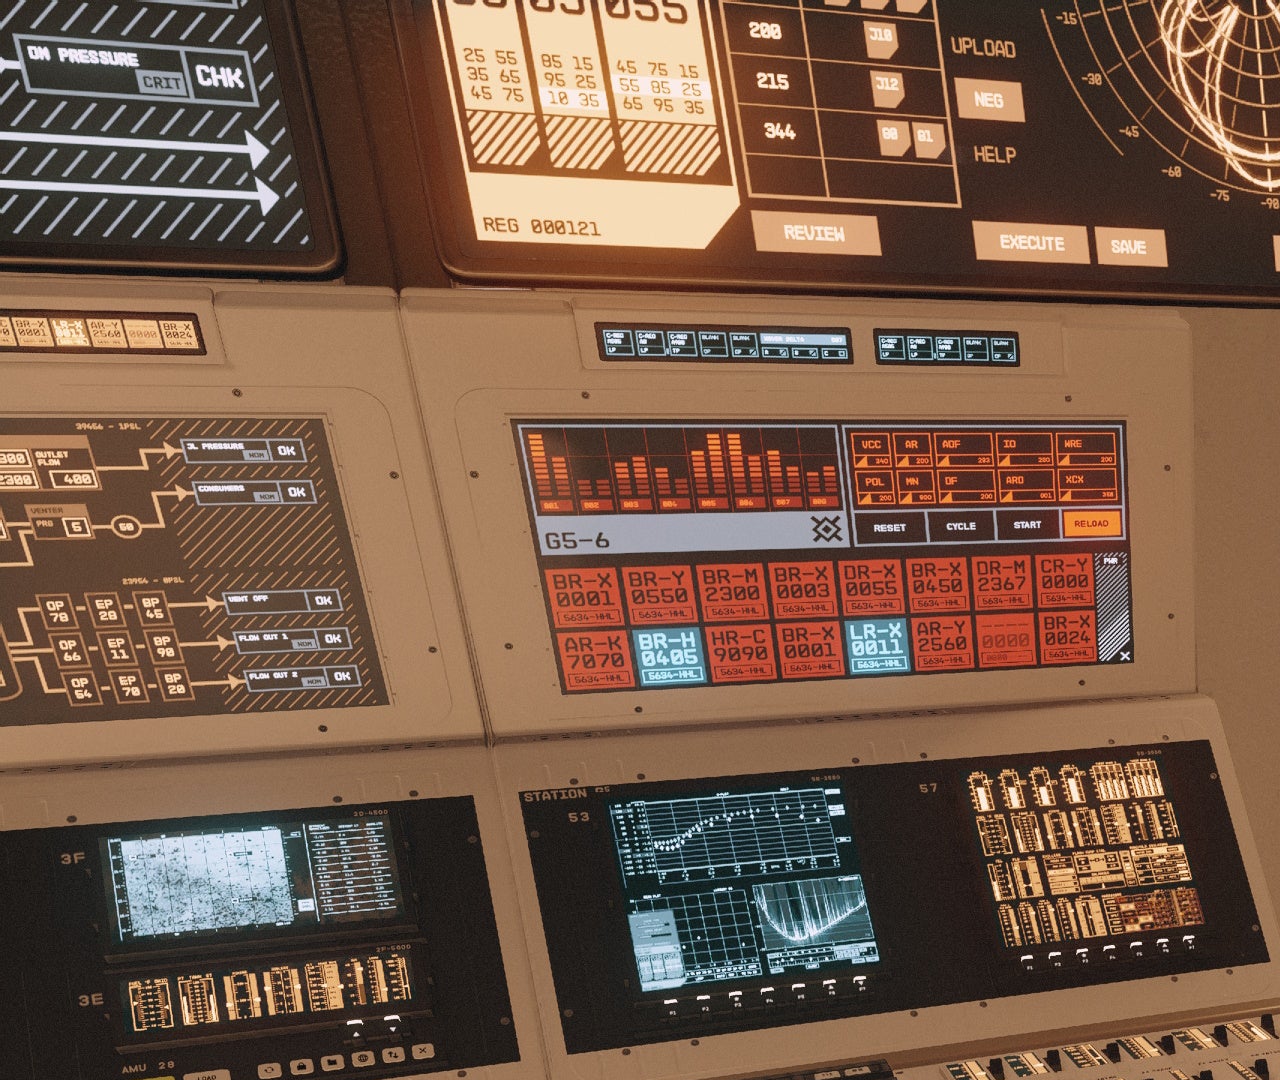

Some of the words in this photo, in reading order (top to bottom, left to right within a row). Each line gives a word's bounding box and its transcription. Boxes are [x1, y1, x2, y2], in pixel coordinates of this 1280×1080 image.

[1056, 12, 1078, 25] -15
[749, 22, 782, 40] 200
[950, 36, 1016, 59] UPLOAD
[58, 47, 140, 68] PRESSURE
[463, 47, 485, 63] 25
[495, 50, 517, 65] 55
[541, 53, 563, 69] 85
[573, 56, 593, 71] 15
[195, 64, 245, 89] CHK
[467, 66, 489, 82] 35
[500, 69, 521, 84] 65
[616, 60, 637, 75] 45
[648, 62, 668, 77] 75
[680, 64, 699, 79] 15
[142, 75, 181, 90] CRIT
[544, 72, 566, 87] 95
[575, 74, 597, 89] 25
[619, 78, 640, 93] 55
[651, 80, 671, 95] 85
[682, 82, 702, 97] 25
[756, 72, 790, 90] 215
[1081, 73, 1102, 86] -30
[471, 85, 492, 100] 45
[502, 87, 524, 102] 75
[549, 90, 569, 106] 10
[579, 93, 599, 108] 35
[973, 90, 1004, 109] NEG
[623, 96, 643, 111] 65
[653, 98, 674, 113] 95
[685, 100, 705, 115] 35
[764, 122, 796, 140] 344
[1119, 125, 1140, 138] -45
[973, 144, 1017, 164] HELP
[1161, 165, 1182, 178] -60
[1210, 190, 1230, 202] -75
[1260, 197, 1280, 210] -90
[483, 217, 520, 234] REG
[531, 218, 602, 237] 000121
[783, 224, 846, 243] REVIEW
[1000, 234, 1065, 252] EXECUTE
[1111, 239, 1147, 256] SAVE
[201, 442, 245, 450] PRESSURE
[277, 445, 296, 456] OK
[861, 440, 882, 449] VCC
[905, 440, 918, 449] AR
[34, 451, 69, 459] OUTLET
[64, 474, 92, 485] 400
[287, 486, 306, 497] OK
[71, 522, 82, 533] 5
[873, 523, 907, 532] RESET
[946, 522, 976, 531] CYCLE
[1013, 521, 1042, 530] START
[1074, 519, 1109, 528] RELOAD
[544, 531, 611, 550] G5-6
[843, 564, 896, 580] DR-X
[911, 561, 962, 578] BR-X
[977, 560, 1026, 576] DR-M
[1040, 557, 1088, 573] CR-Y
[552, 572, 613, 590] BR-X
[628, 570, 685, 587] BR-Y
[702, 568, 758, 585] BR-M
[774, 566, 828, 582] BR-X
[1041, 573, 1089, 589] 0000
[777, 583, 830, 599] 0003
[846, 581, 897, 596] 0055
[913, 578, 963, 594] 0450
[977, 576, 1026, 592] 2367
[315, 595, 333, 606] OK
[556, 590, 615, 607] 0001
[631, 588, 688, 605] 0550
[706, 585, 761, 602] 2300
[46, 600, 64, 611] OP
[95, 599, 113, 610] EP
[142, 597, 160, 608] BP
[917, 620, 966, 636] AR-Y
[1043, 614, 1090, 630] BR-X
[324, 633, 342, 644] OK
[711, 629, 767, 645] HR-C
[782, 626, 835, 642] BR-X
[849, 622, 903, 640] LR-X
[1045, 631, 1091, 645] 0024
[58, 639, 77, 650] OP
[107, 638, 125, 648] EP
[153, 636, 171, 646] BP
[564, 635, 622, 653] AR-K
[638, 631, 696, 650] BR-H
[851, 638, 904, 656] 0011
[919, 636, 967, 652] 2560
[982, 633, 1031, 648] 0000
[642, 648, 698, 667] 0405
[714, 647, 768, 662] 9090
[785, 642, 837, 658] 0001
[566, 653, 625, 670] 7070
[71, 677, 89, 688] OP
[118, 676, 137, 686] EP
[164, 673, 182, 684] BP
[334, 671, 352, 682] OK
[524, 788, 588, 803] STATION
[919, 783, 938, 794] 57
[568, 812, 590, 823] 53
[60, 852, 85, 866] 3F
[78, 993, 103, 1007] 3E
[121, 1063, 147, 1075] AMU
[158, 1060, 175, 1070] 28
